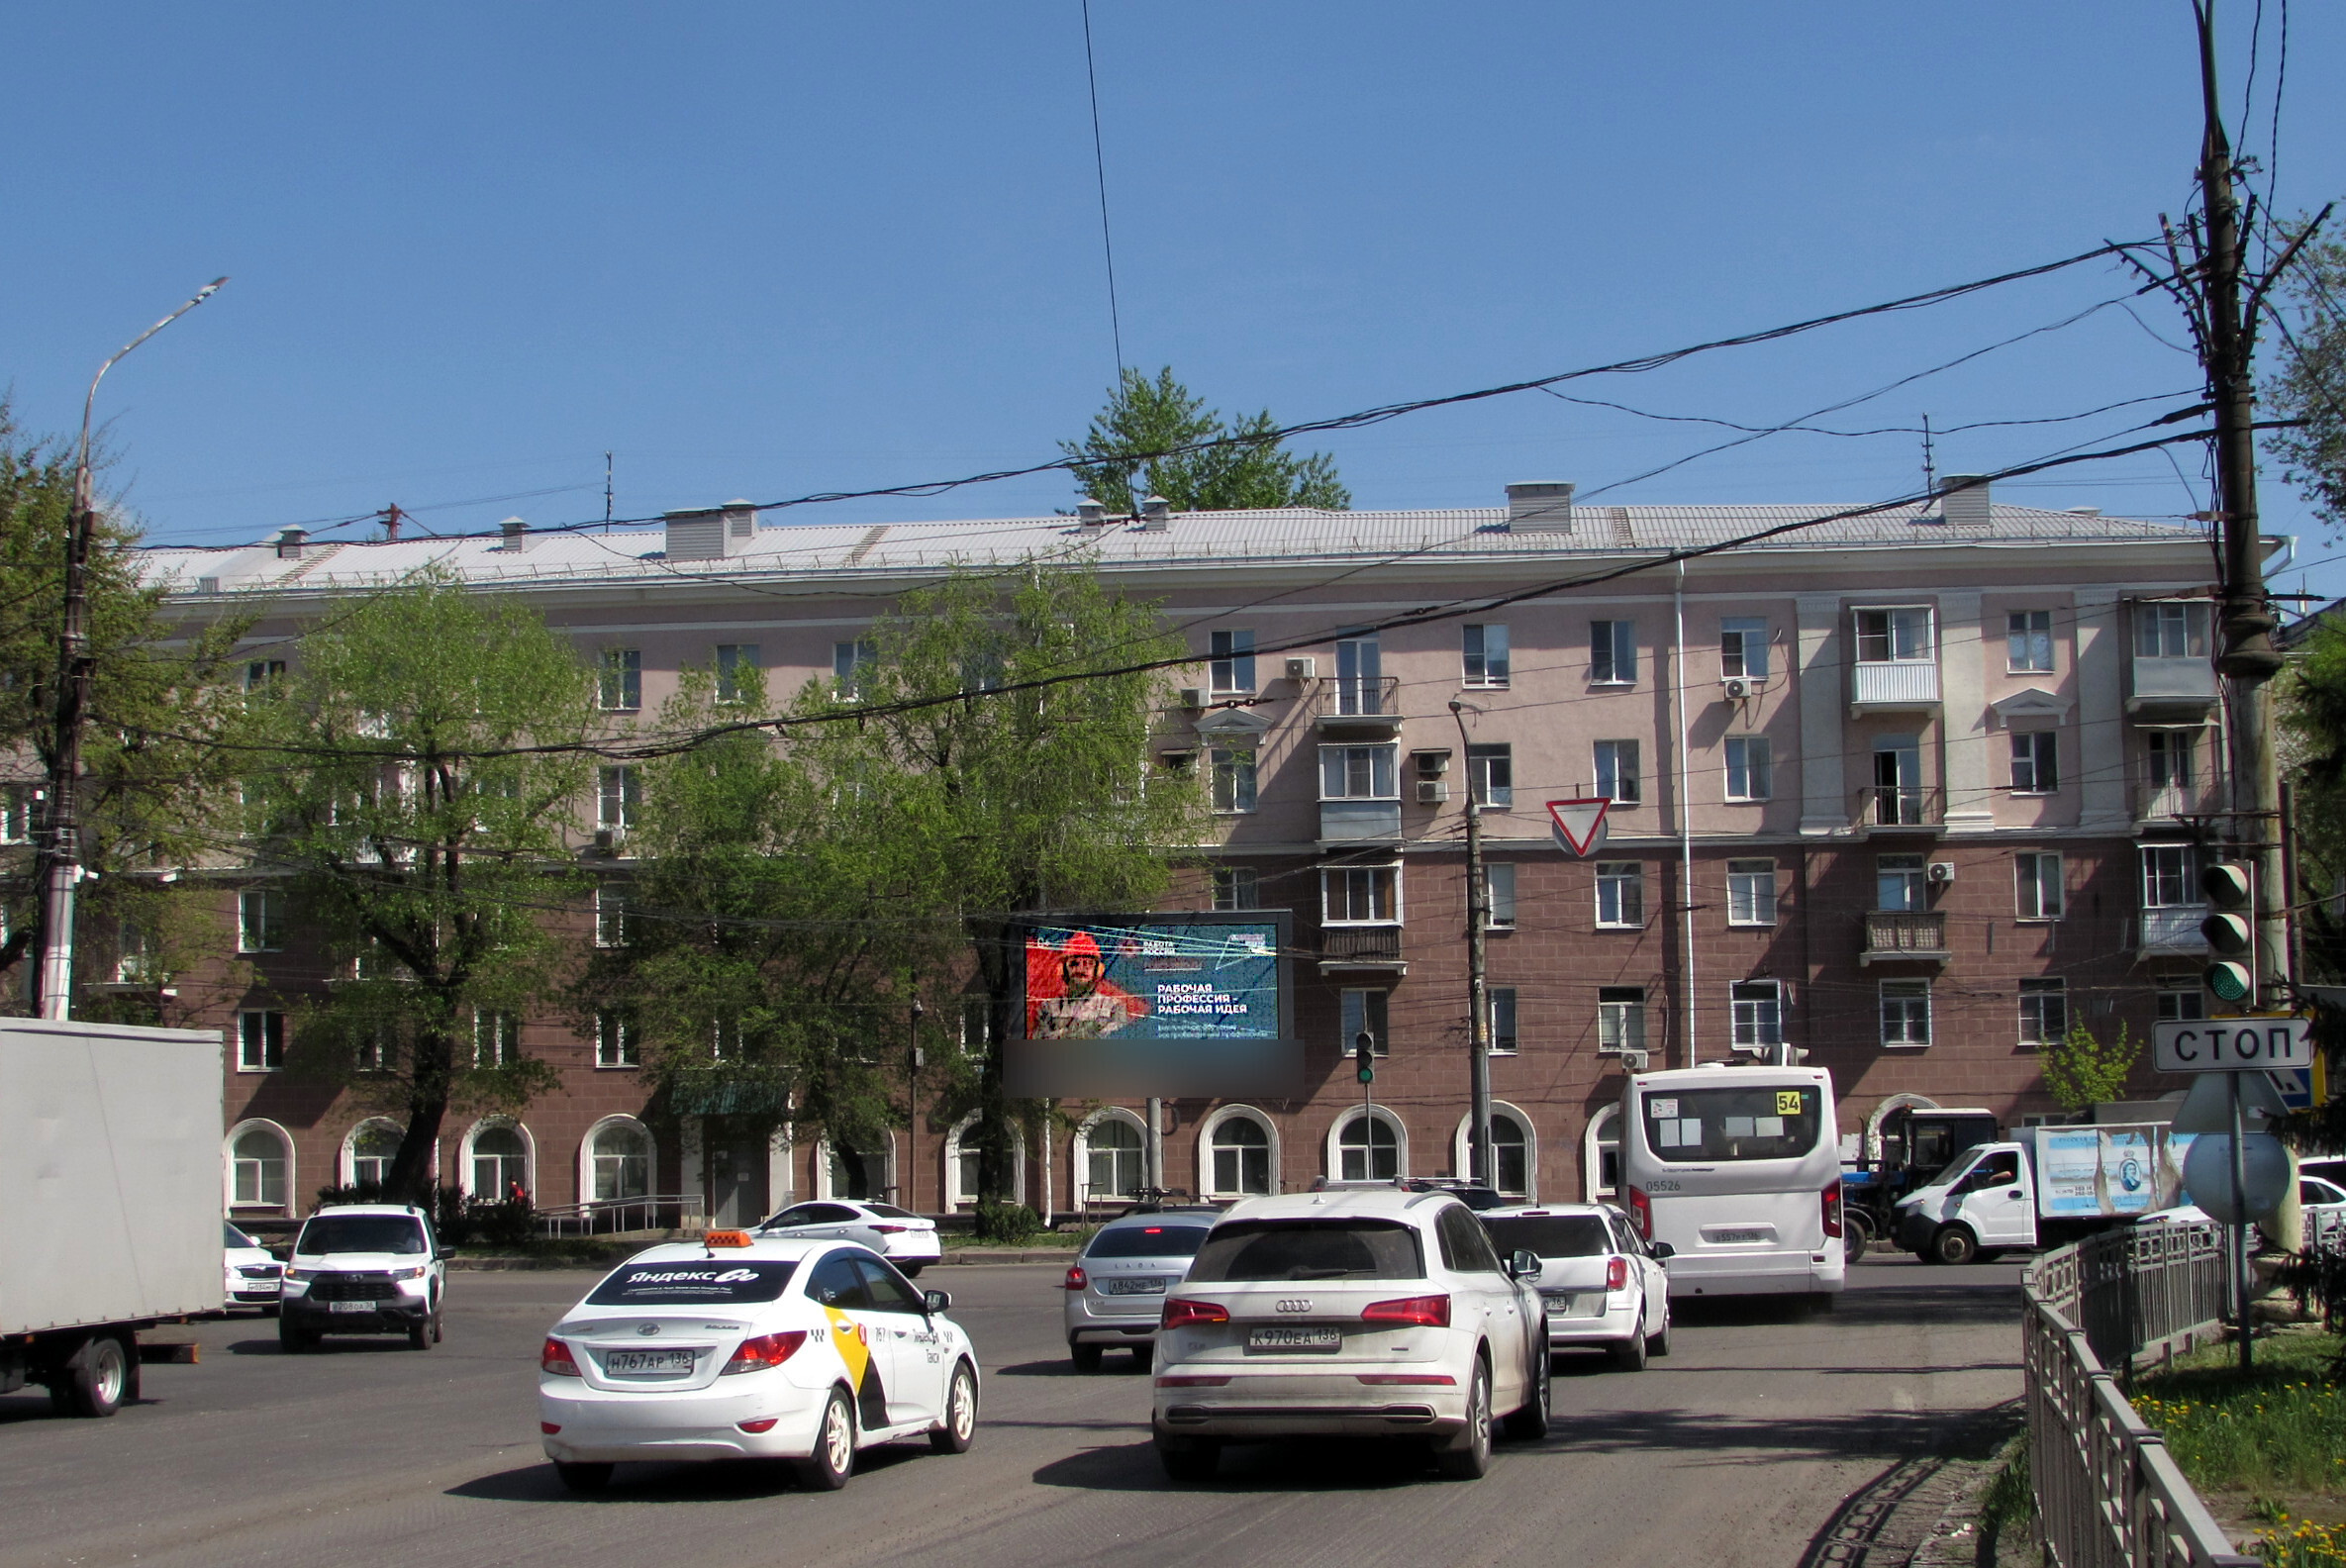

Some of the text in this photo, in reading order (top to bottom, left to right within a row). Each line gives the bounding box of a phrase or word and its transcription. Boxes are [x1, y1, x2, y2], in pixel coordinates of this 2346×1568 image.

[1157, 984, 1213, 993] РАБОЧАЯ
[1157, 995, 1230, 1004] ПРОФЕССИЯ
[1157, 1005, 1247, 1014] РАБОЧАЯ ИДЕЯ
[2174, 1028, 2292, 1062] СТОП
[1778, 1095, 1800, 1111] 54
[1645, 1181, 1681, 1192] 05526
[627, 1271, 718, 1283] Яндекс
[1254, 1328, 1336, 1345] К970ЕА 136
[611, 1352, 689, 1369] Н767АР 136
